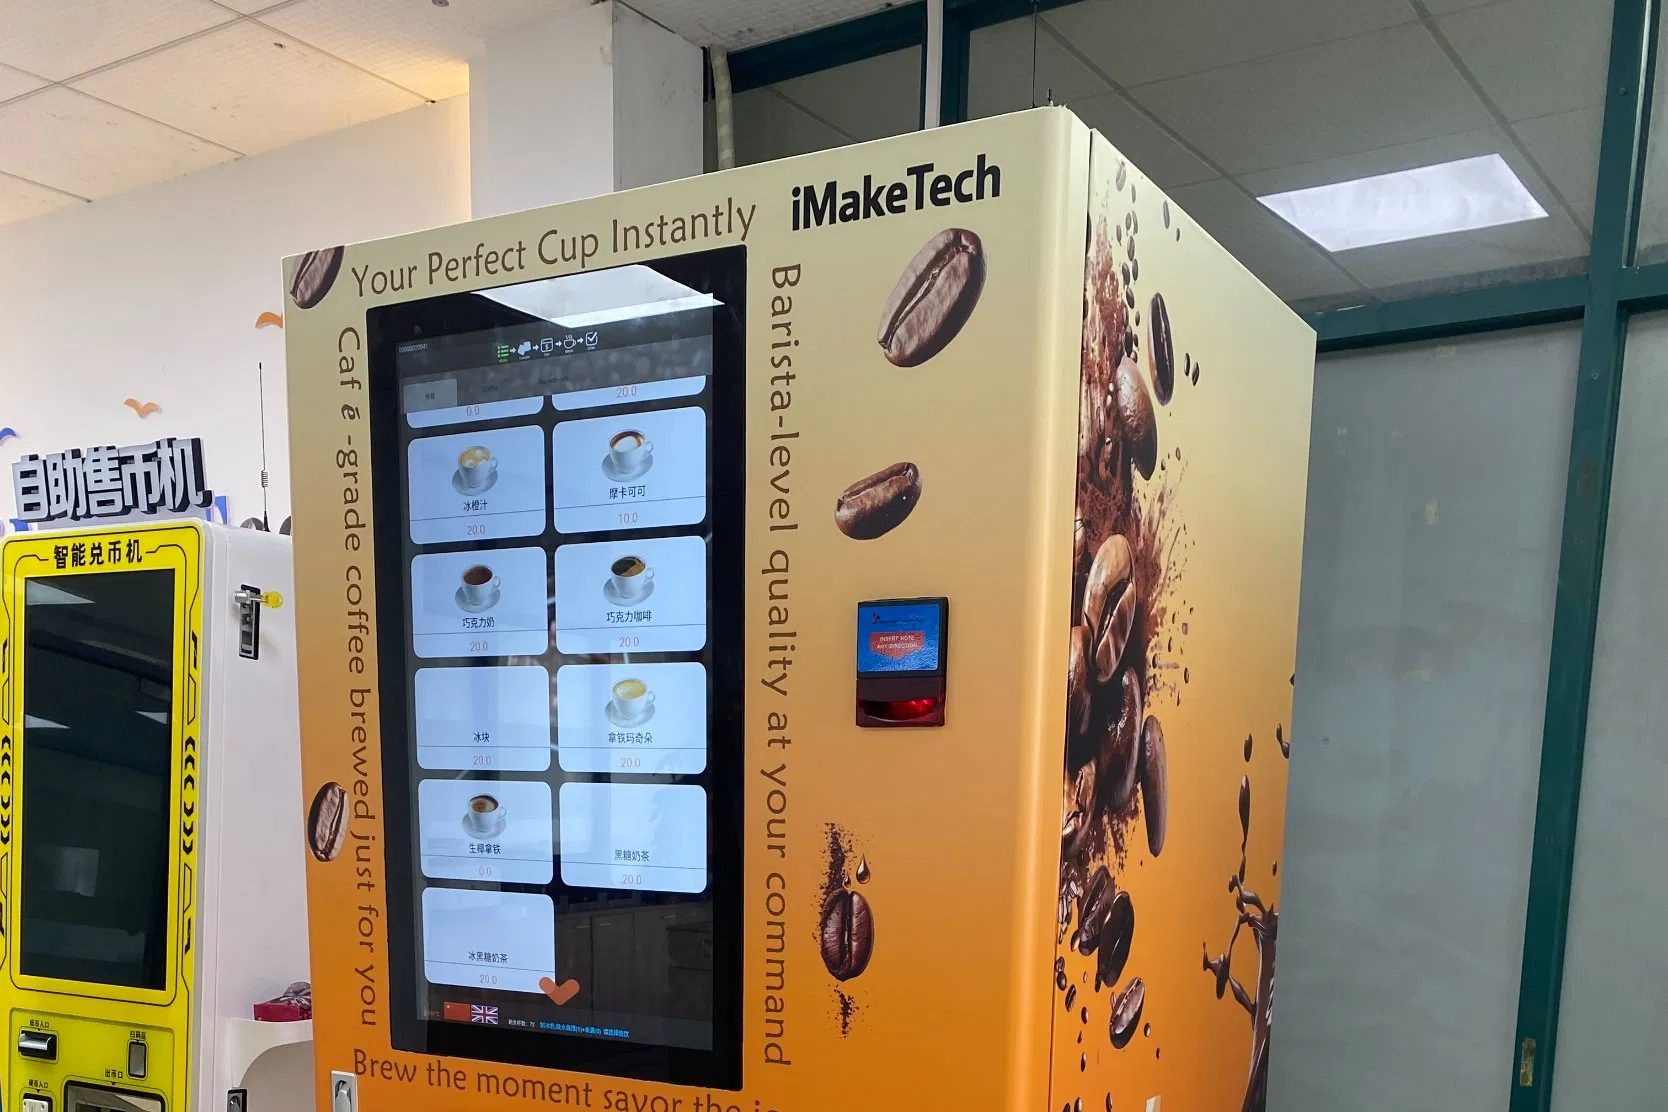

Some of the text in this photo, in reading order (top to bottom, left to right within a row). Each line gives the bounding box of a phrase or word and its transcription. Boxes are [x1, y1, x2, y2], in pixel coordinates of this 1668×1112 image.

[792, 153, 1001, 231] iMakeTech
[351, 197, 756, 297] Your Perfect Cup Instantly
[616, 386, 637, 398] 20.0
[12, 437, 212, 521] 自助售币机
[609, 485, 646, 499] 摩卡可可
[463, 499, 488, 511] 冰橙汁
[618, 512, 638, 524] 10.0
[467, 524, 486, 536] 20.0
[53, 539, 143, 570] 智能兑币机
[345, 565, 369, 674] coffee
[606, 610, 652, 623] 巧克力咖啡
[462, 617, 495, 629] 巧克力奶
[470, 641, 489, 652] 20.0
[619, 637, 640, 648] 20.0
[760, 263, 802, 1066] Barista-level quality at your command
[473, 732, 490, 743] 冰块
[608, 732, 653, 744] 拿铁玛奇朵
[350, 688, 375, 820] brewed
[473, 755, 492, 766] 20.0
[621, 757, 641, 768] 20.0
[350, 830, 376, 892] just
[614, 850, 650, 862] 黑糖奶茶
[622, 874, 642, 885] 20.0
[356, 904, 379, 953] for
[468, 950, 508, 964] 冰黑糖奶茶
[479, 974, 498, 985] 20.0
[355, 963, 376, 1026] you
[29, 1019, 50, 1029] 纸币入口
[104, 1069, 123, 1079] 出币口
[353, 1049, 417, 1083] Brew
[426, 1060, 466, 1090] the
[477, 1069, 592, 1108] moment
[28, 1079, 49, 1088] 硬币入口
